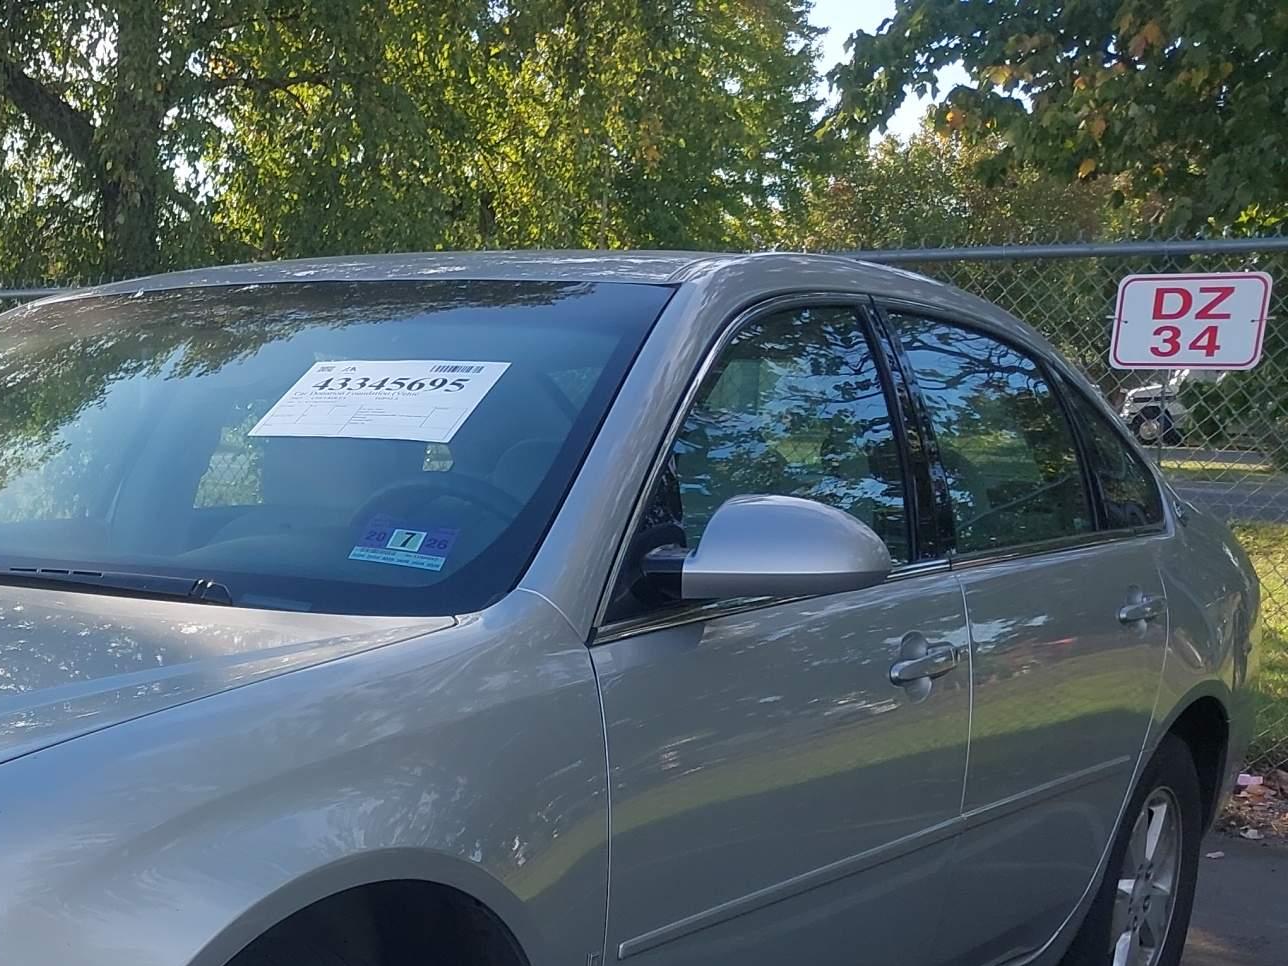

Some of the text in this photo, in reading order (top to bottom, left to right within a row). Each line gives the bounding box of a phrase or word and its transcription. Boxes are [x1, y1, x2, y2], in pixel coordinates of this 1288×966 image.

[1152, 287, 1236, 320] DZ
[1150, 325, 1221, 358] 34
[312, 376, 471, 393] 43345695
[400, 532, 417, 548] 7
[425, 539, 448, 550] 26
